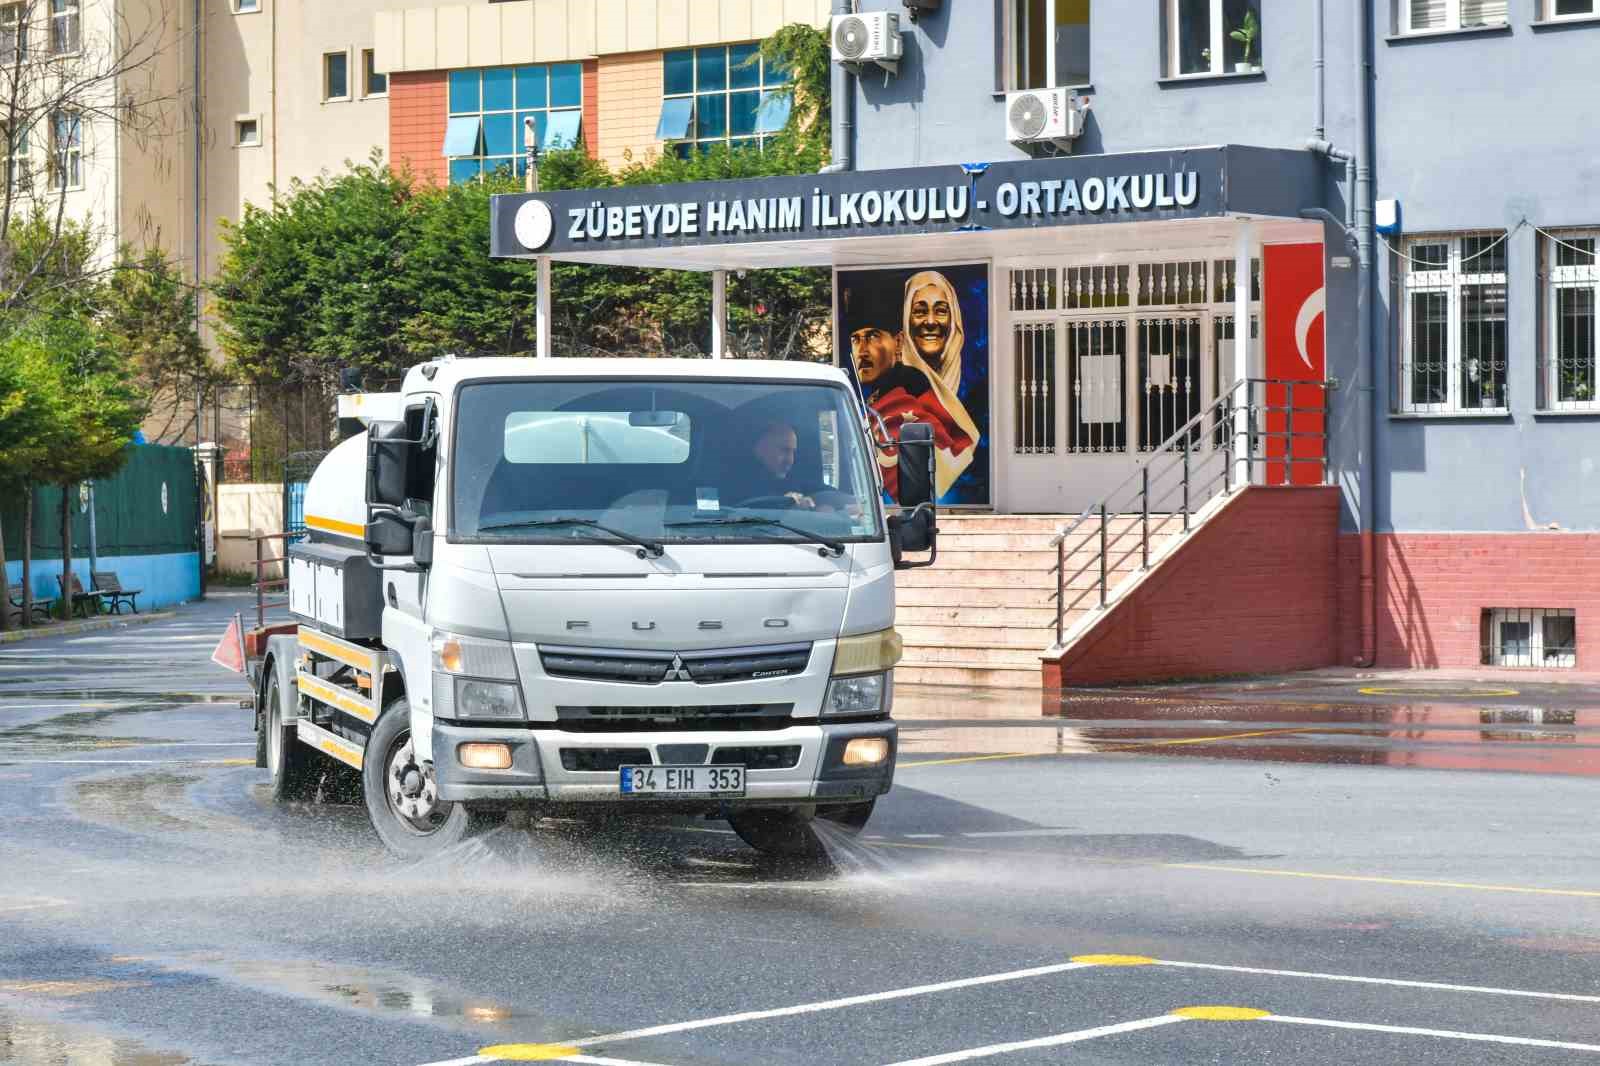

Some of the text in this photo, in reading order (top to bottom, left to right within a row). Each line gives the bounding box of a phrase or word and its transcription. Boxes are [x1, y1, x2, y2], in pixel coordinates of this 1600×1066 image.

[568, 202, 697, 239] ZÜBEYDE
[707, 197, 801, 232] HANIM
[812, 186, 968, 226] İLKOKULU
[996, 172, 1197, 216] ORTAOKULU
[566, 618, 789, 630] FUSO
[634, 769, 740, 790] 34 EIH 353
